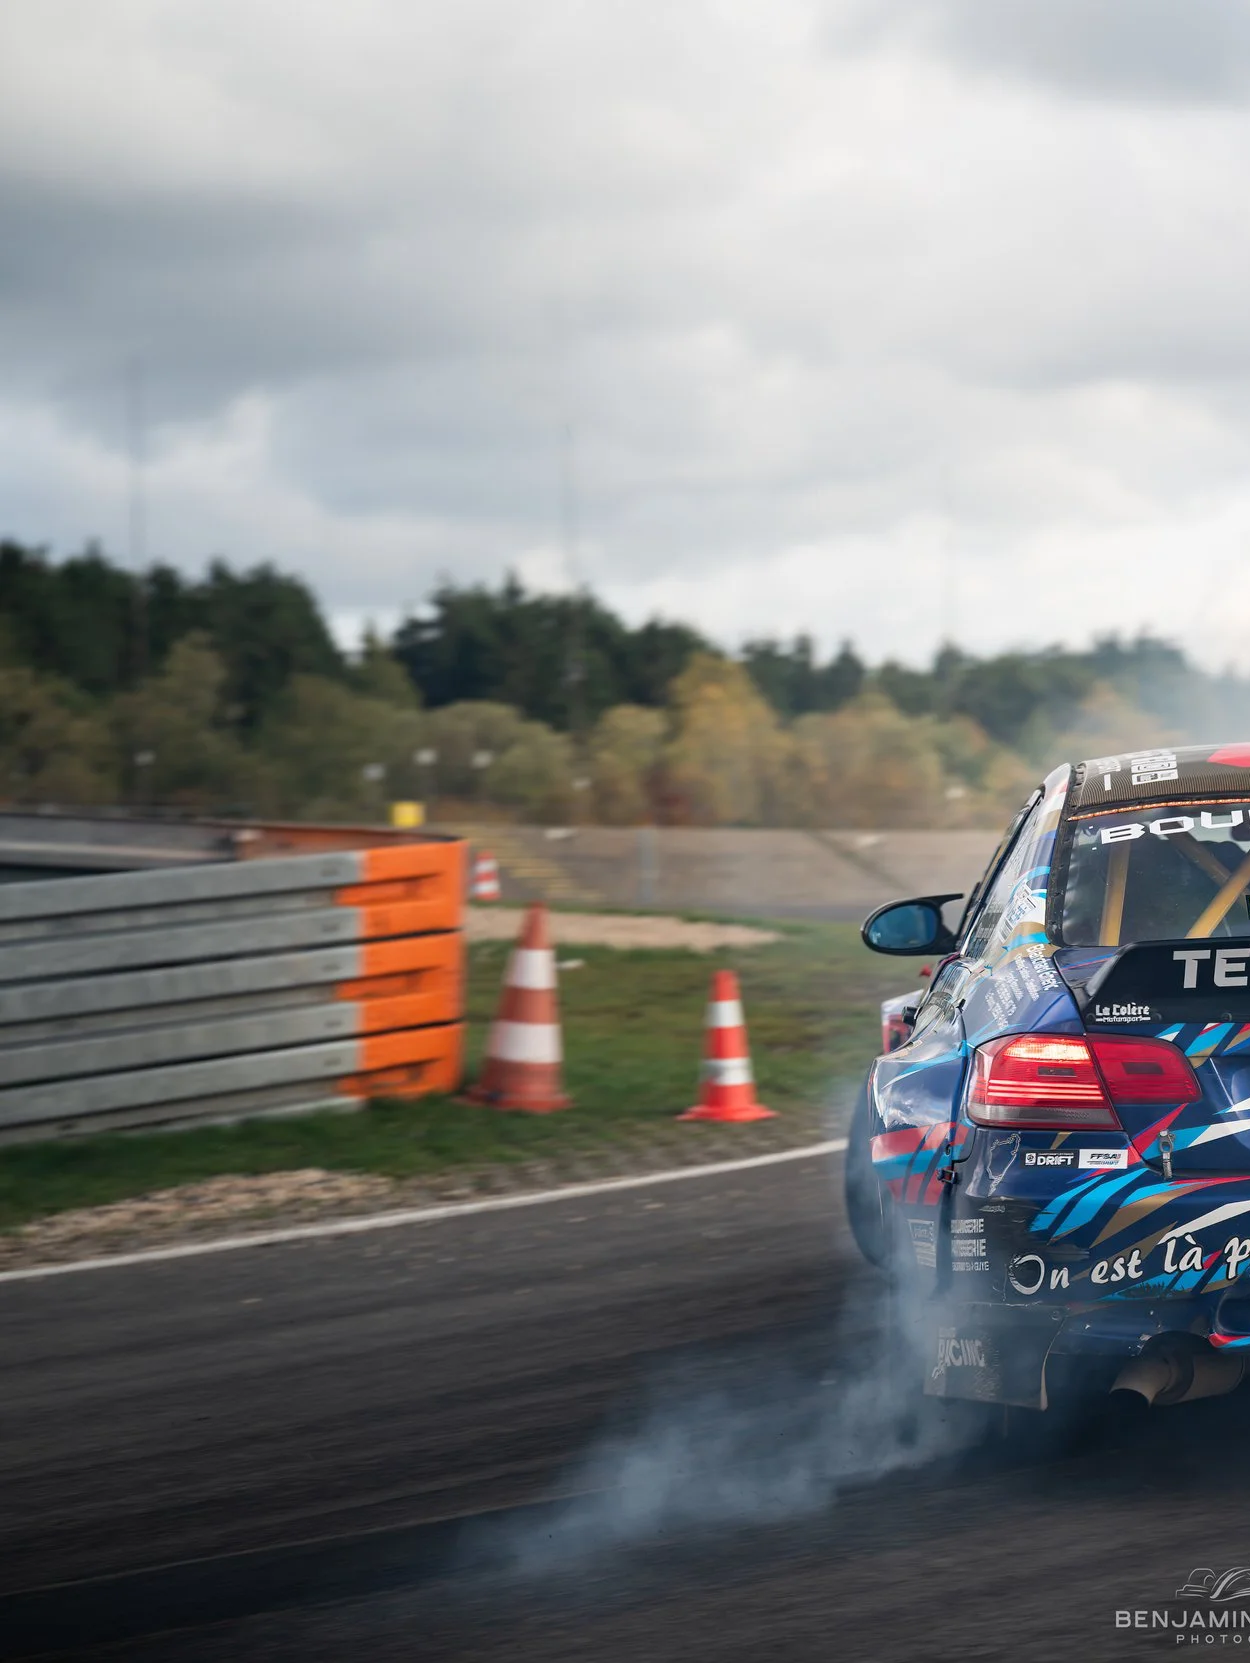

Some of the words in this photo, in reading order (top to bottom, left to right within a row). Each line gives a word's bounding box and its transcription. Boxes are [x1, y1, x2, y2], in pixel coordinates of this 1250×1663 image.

[1095, 1004, 1110, 1016] La
[1036, 1155, 1074, 1166] DRIFT
[1091, 1248, 1144, 1284] est
[1164, 1233, 1203, 1273] là
